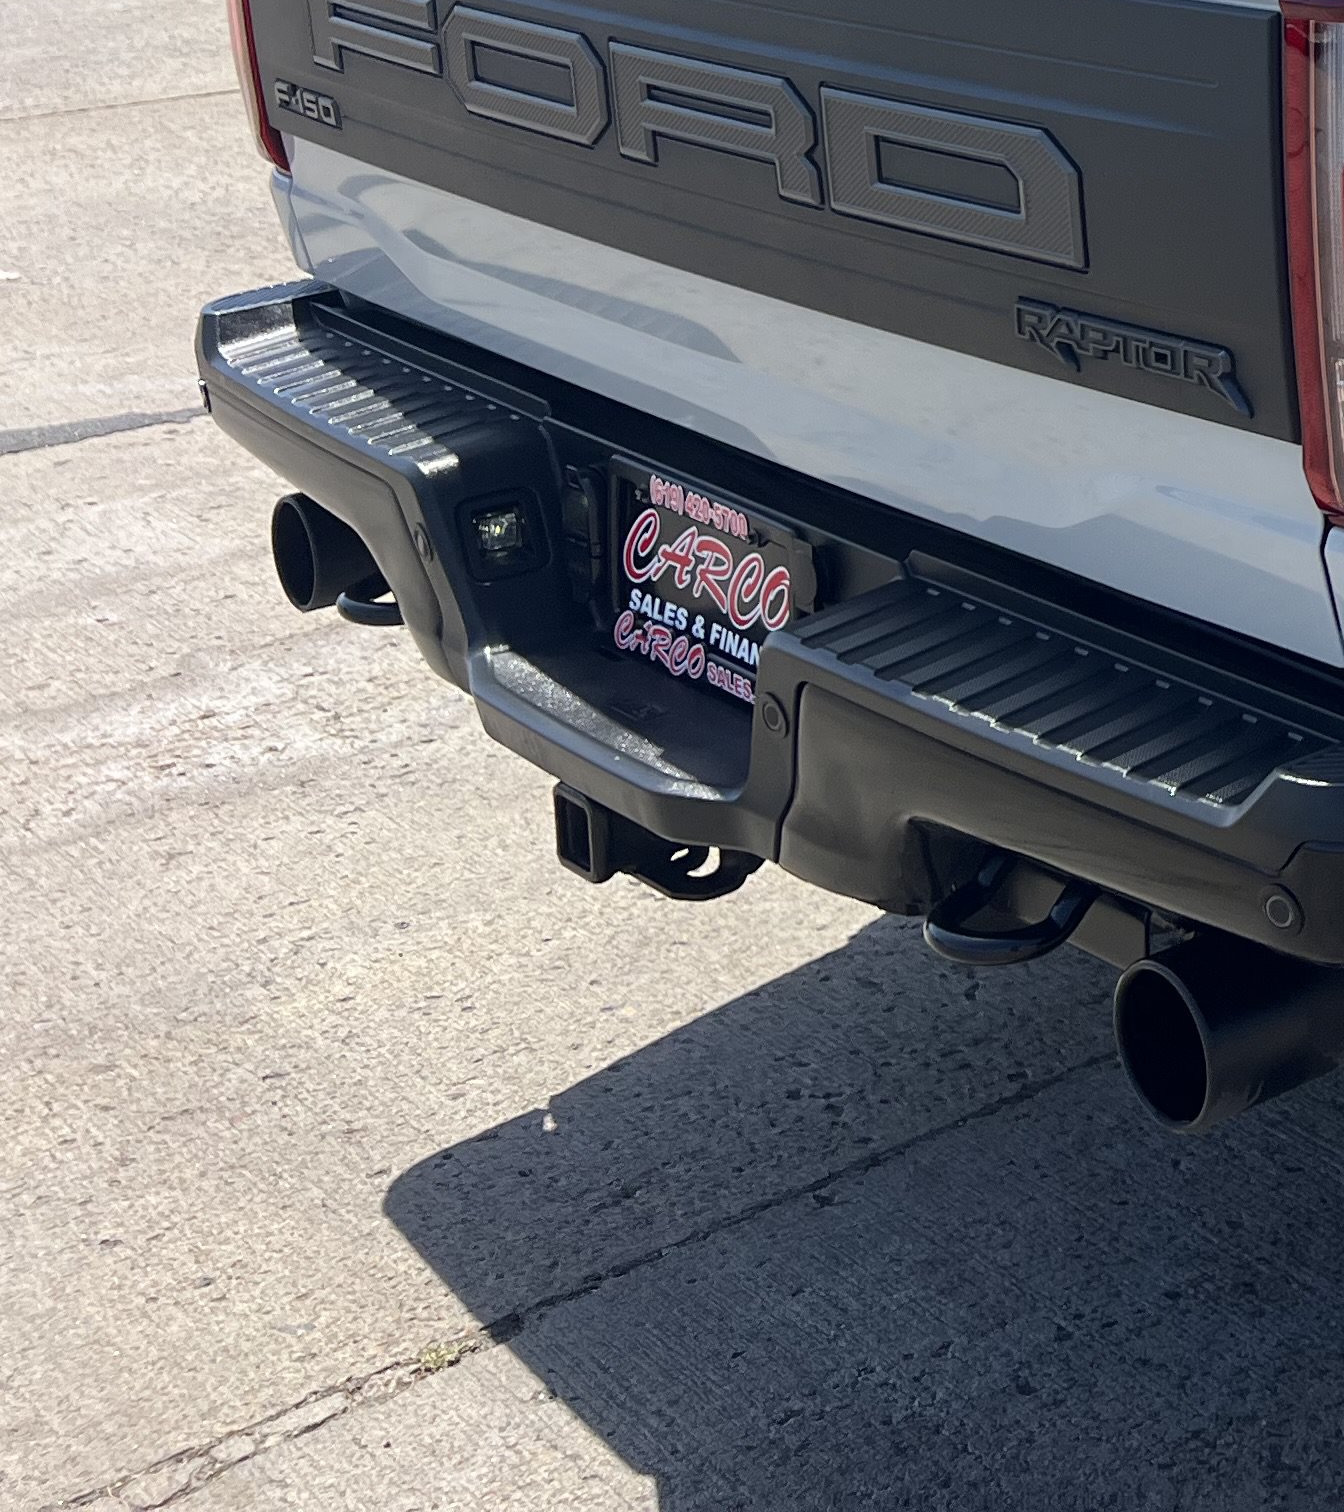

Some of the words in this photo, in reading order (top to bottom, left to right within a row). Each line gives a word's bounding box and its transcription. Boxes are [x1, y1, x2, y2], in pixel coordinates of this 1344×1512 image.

[1014, 295, 1254, 418] RAPTOR
[650, 474, 684, 514] (619)
[624, 508, 790, 631] CARCO
[614, 610, 705, 679] CARCO
[629, 588, 688, 630] SALES
[692, 616, 705, 639] &
